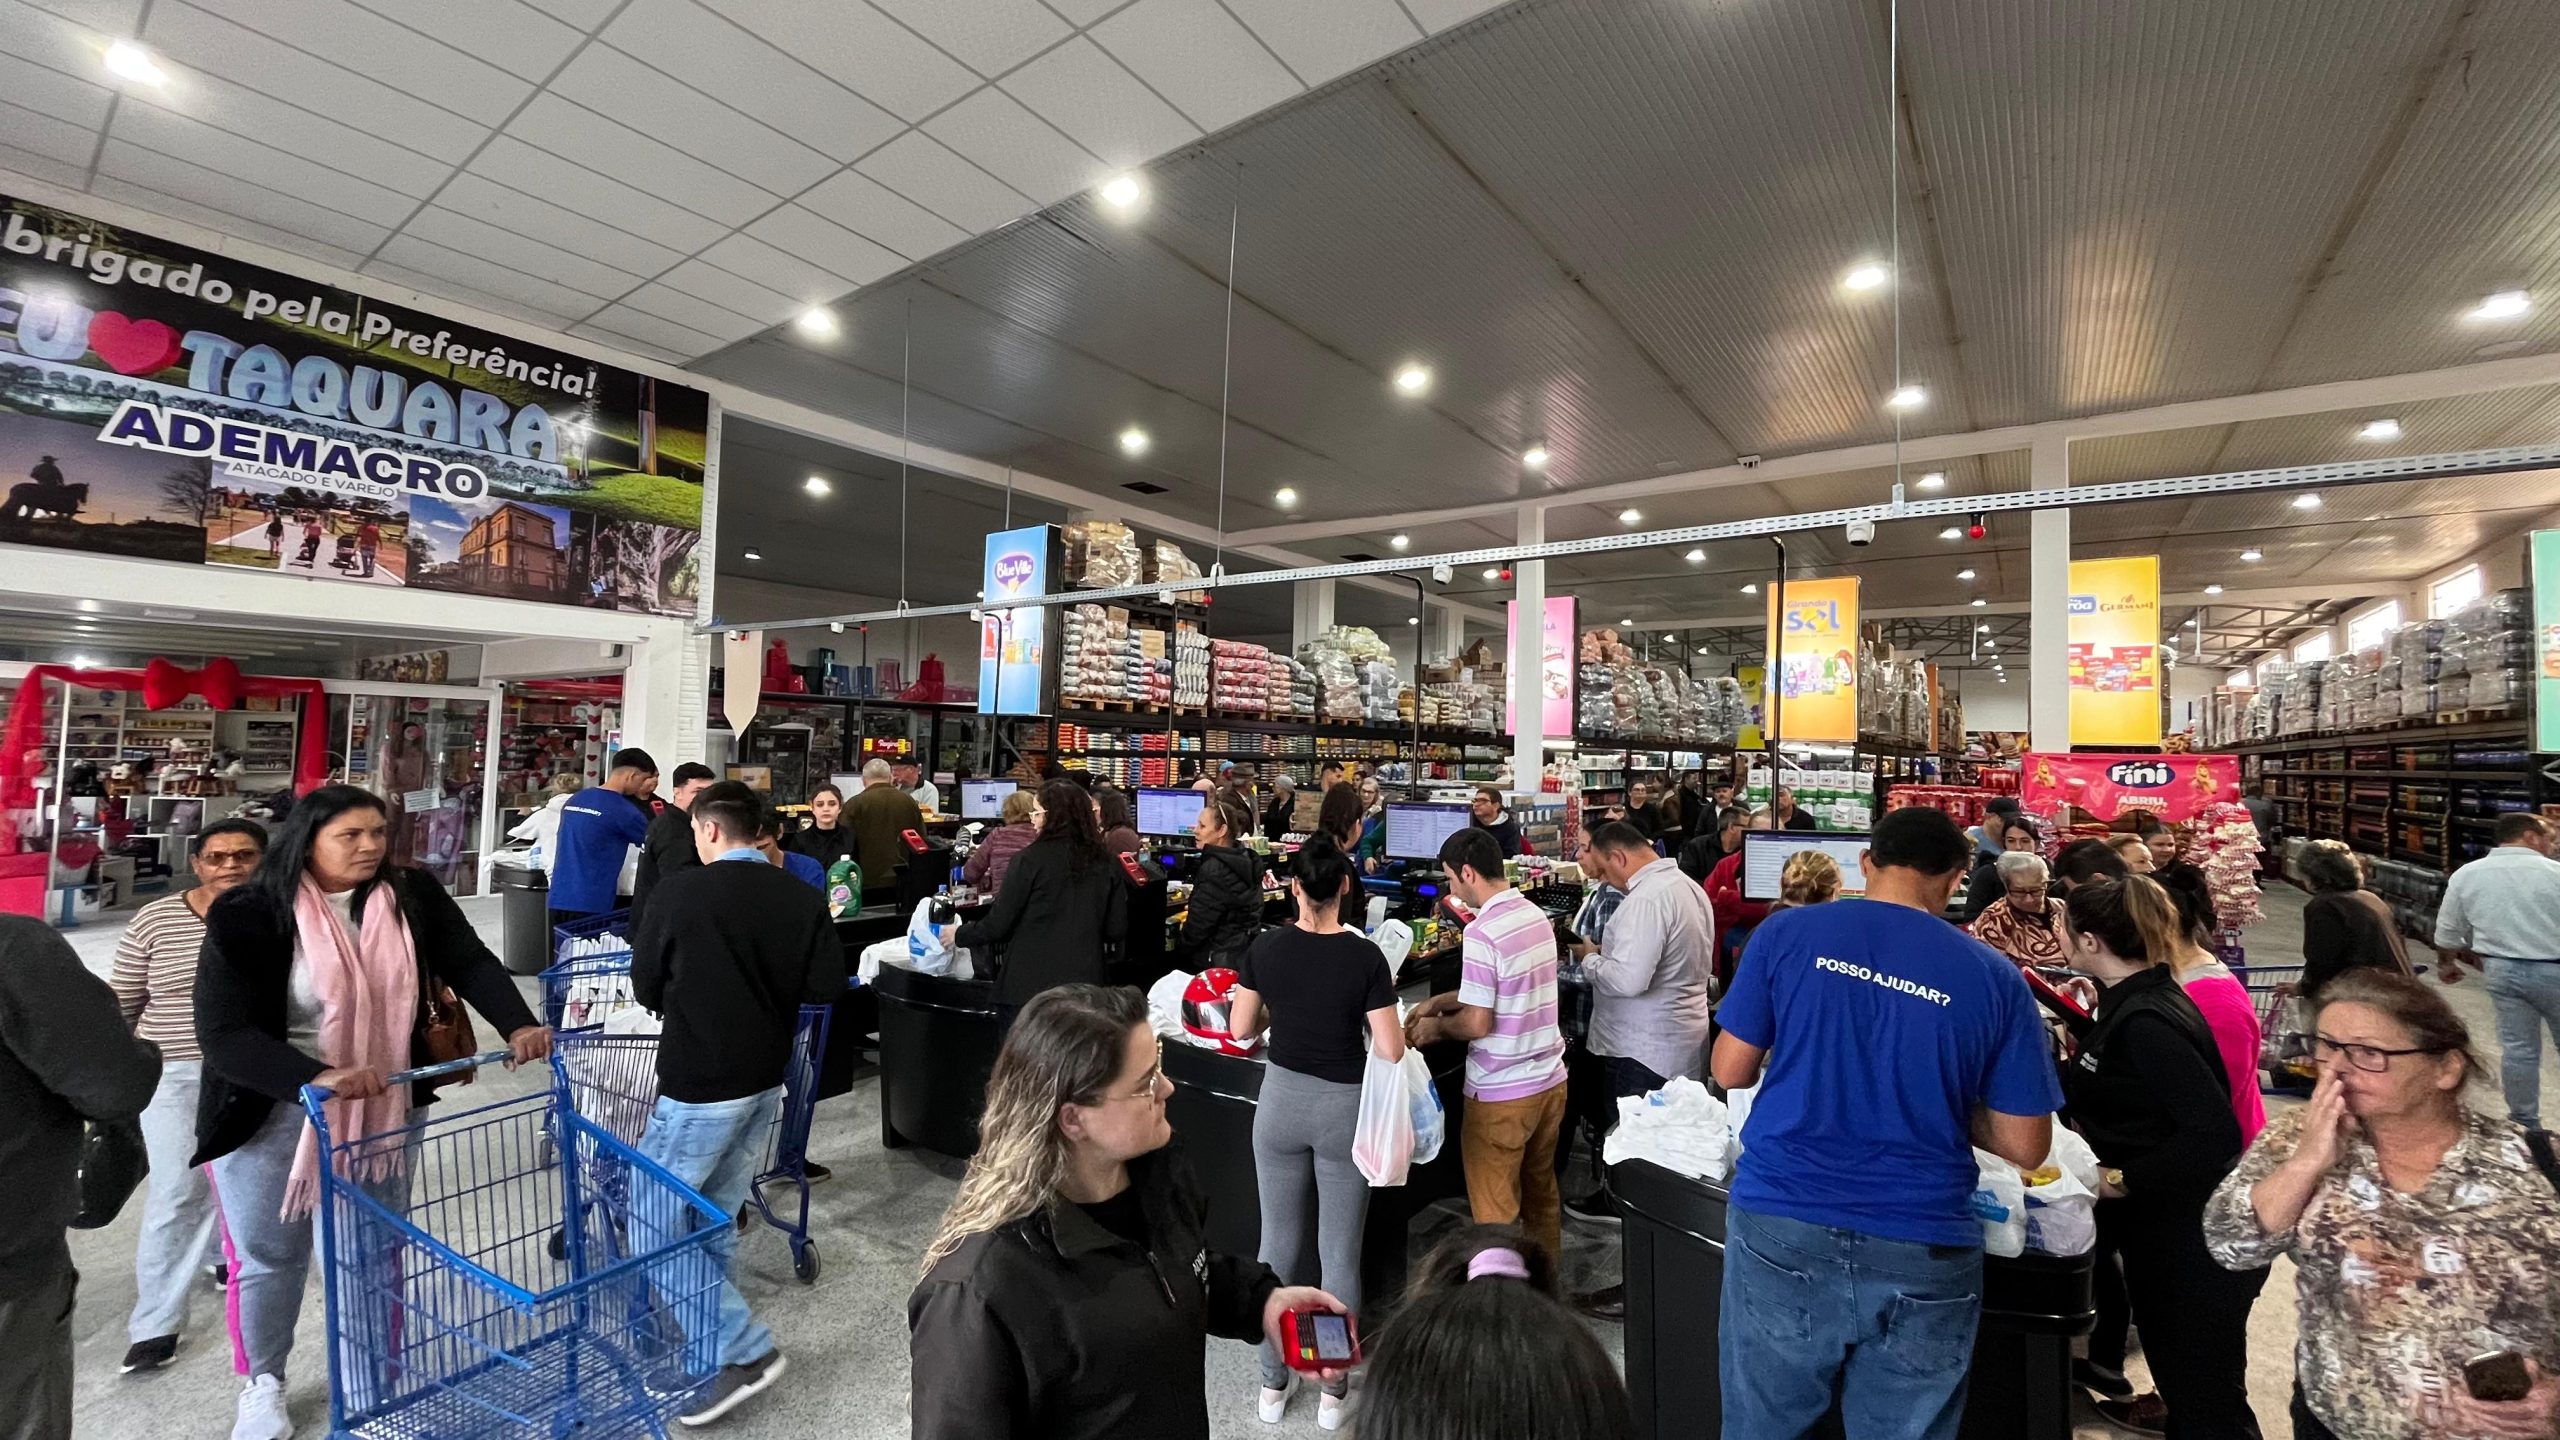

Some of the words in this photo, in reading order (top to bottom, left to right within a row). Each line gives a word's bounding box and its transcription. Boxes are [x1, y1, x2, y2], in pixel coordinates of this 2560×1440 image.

[0, 213, 233, 303] brigado
[243, 288, 350, 335] pela
[361, 312, 597, 398] Preferência!
[181, 330, 559, 464] TAQUARA
[111, 406, 484, 499] ADEMACRO
[232, 462, 317, 484] ATACADO
[322, 477, 331, 487] E
[335, 479, 395, 497] VAREJO
[2112, 763, 2168, 784] Fini
[1815, 957, 1871, 981] POSSO
[1872, 972, 1951, 1006] AJUDAR?
